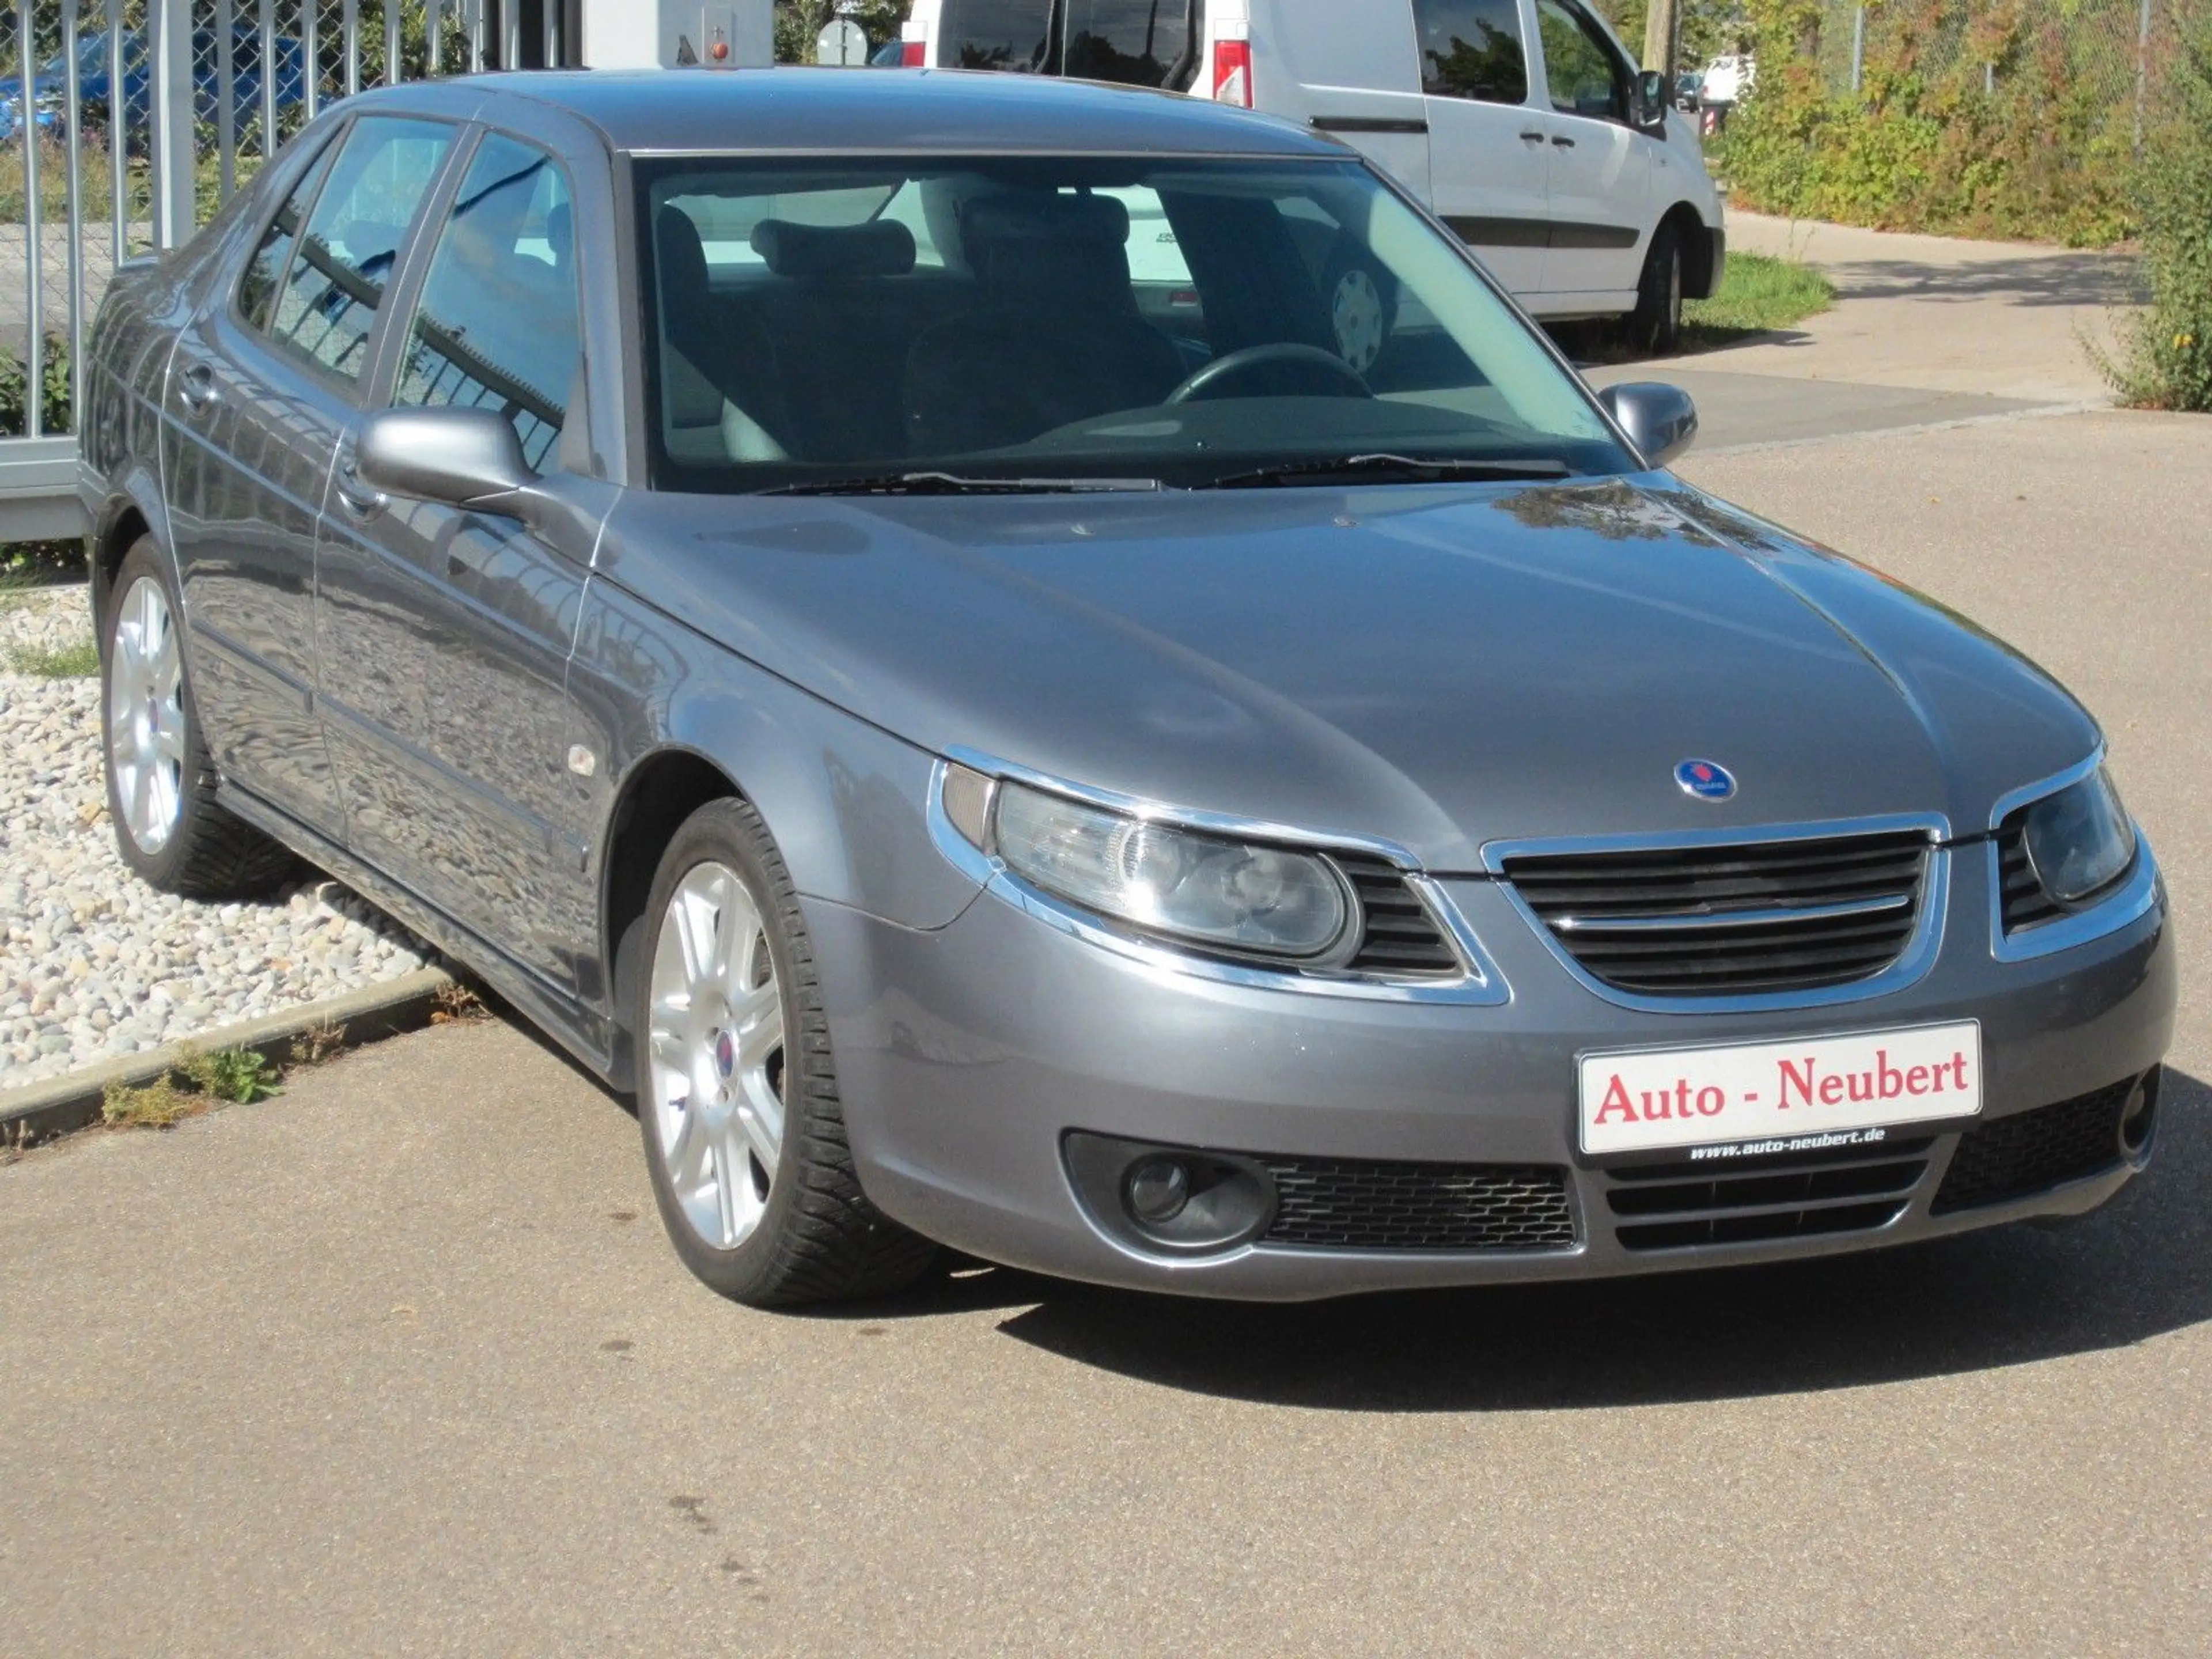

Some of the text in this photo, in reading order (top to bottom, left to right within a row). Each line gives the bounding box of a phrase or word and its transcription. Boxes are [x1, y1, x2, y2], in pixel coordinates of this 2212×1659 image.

[1593, 1050, 1968, 1124] Auto - Neubert
[1690, 1128, 1885, 1160] www.auto-neubert.de
